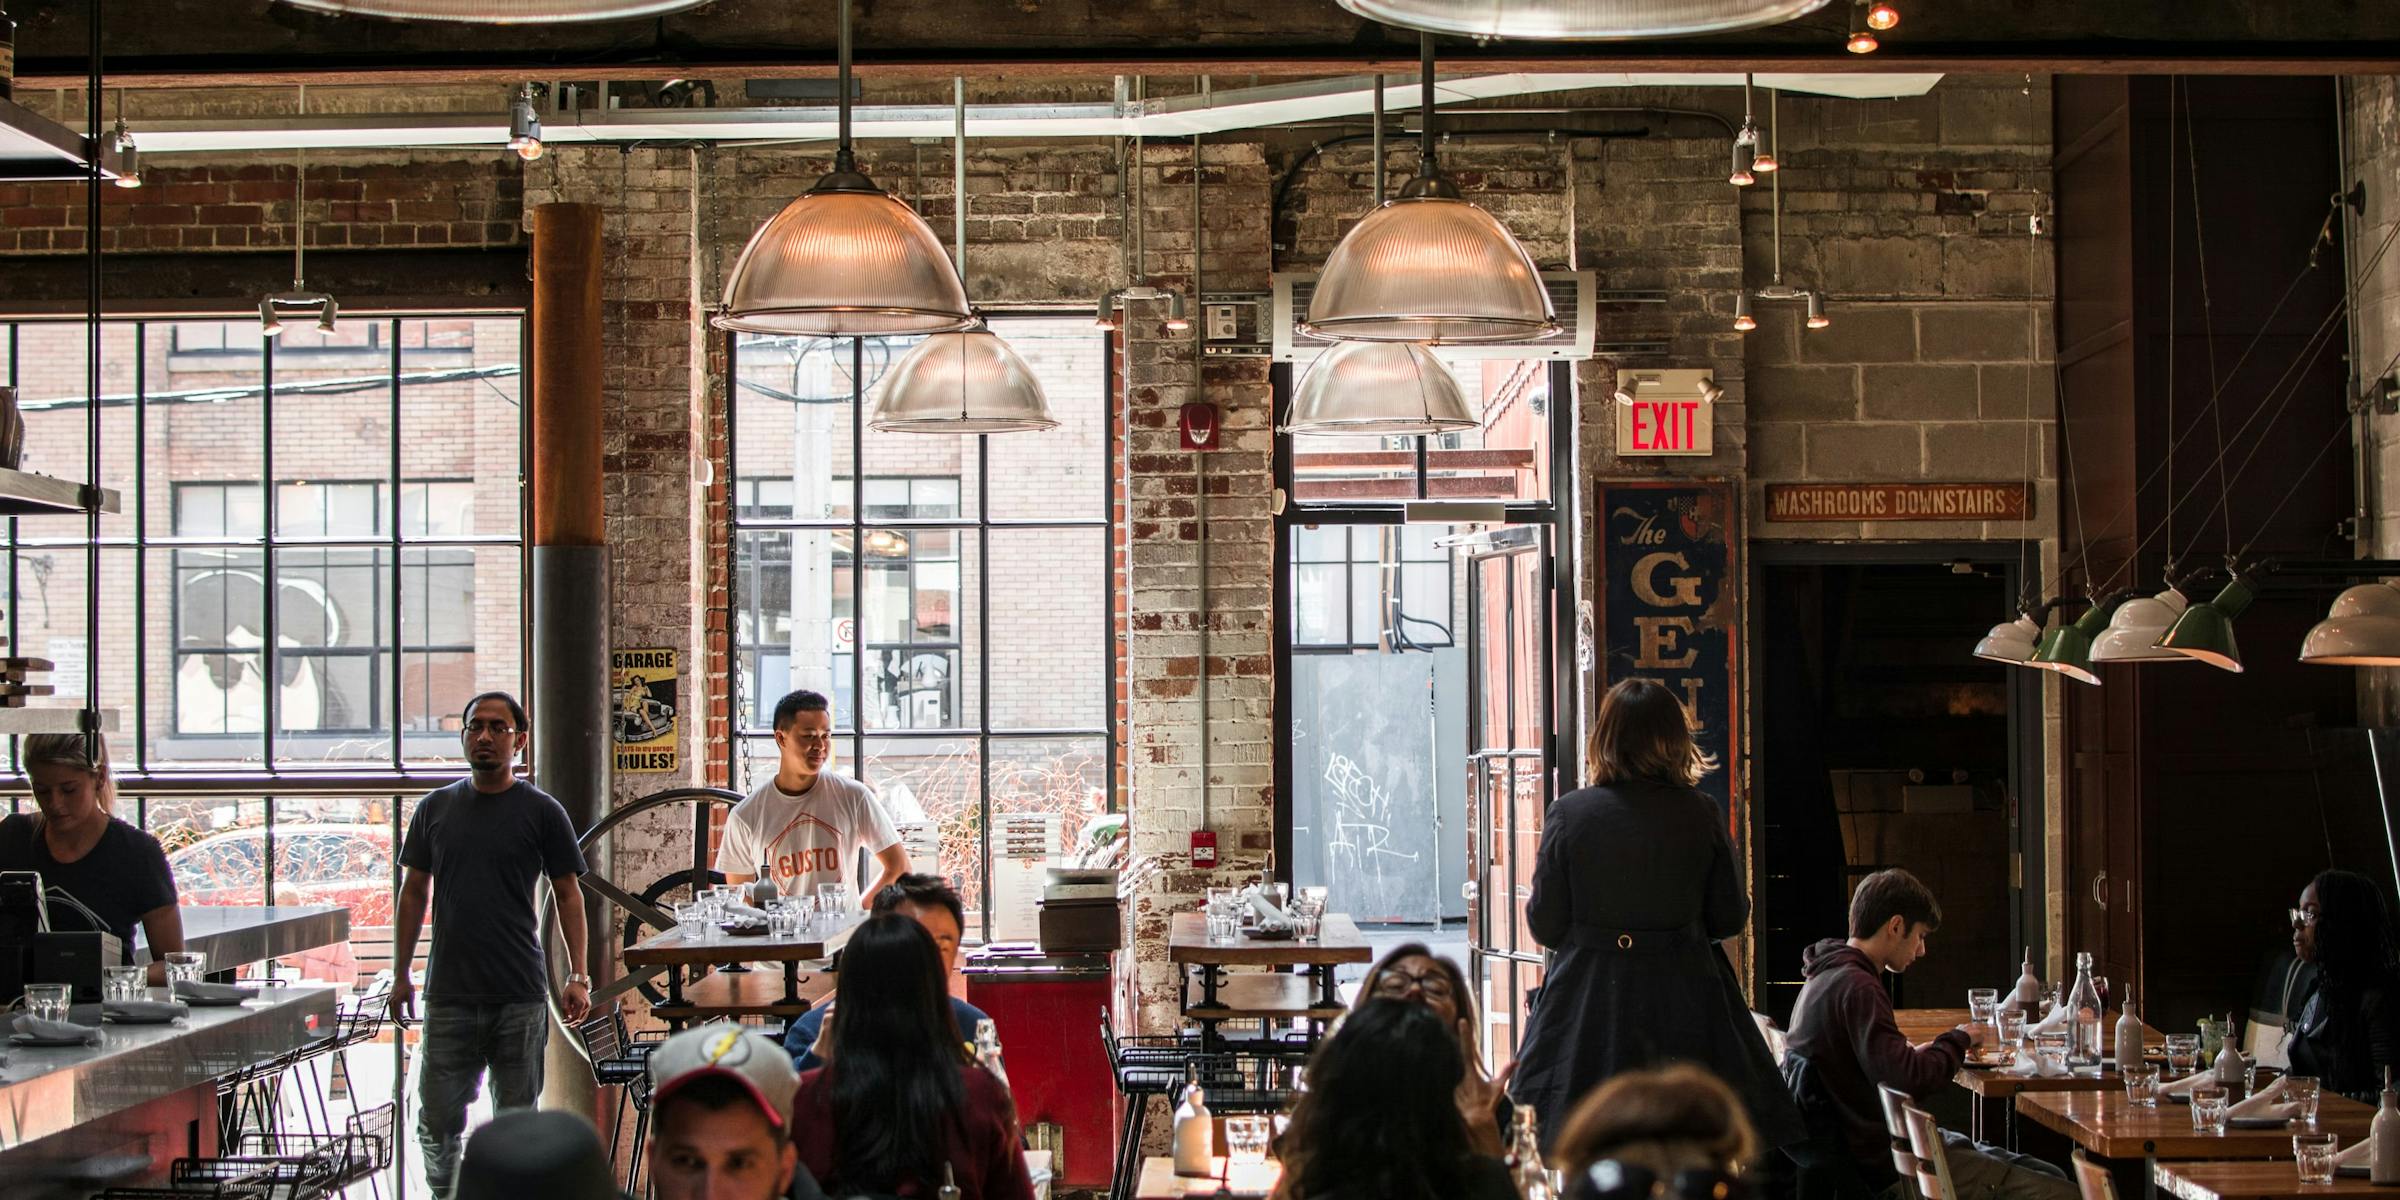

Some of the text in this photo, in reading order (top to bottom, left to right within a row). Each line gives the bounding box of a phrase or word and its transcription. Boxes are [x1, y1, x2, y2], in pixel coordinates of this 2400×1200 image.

[1632, 402, 1698, 450] EXIT
[1775, 489, 2006, 515] WASHROOMS DOWNSTAIRS
[1612, 506, 1667, 545] The
[613, 652, 673, 669] GARAGE
[617, 753, 675, 769] RULES!
[778, 847, 839, 879] GUSTO
